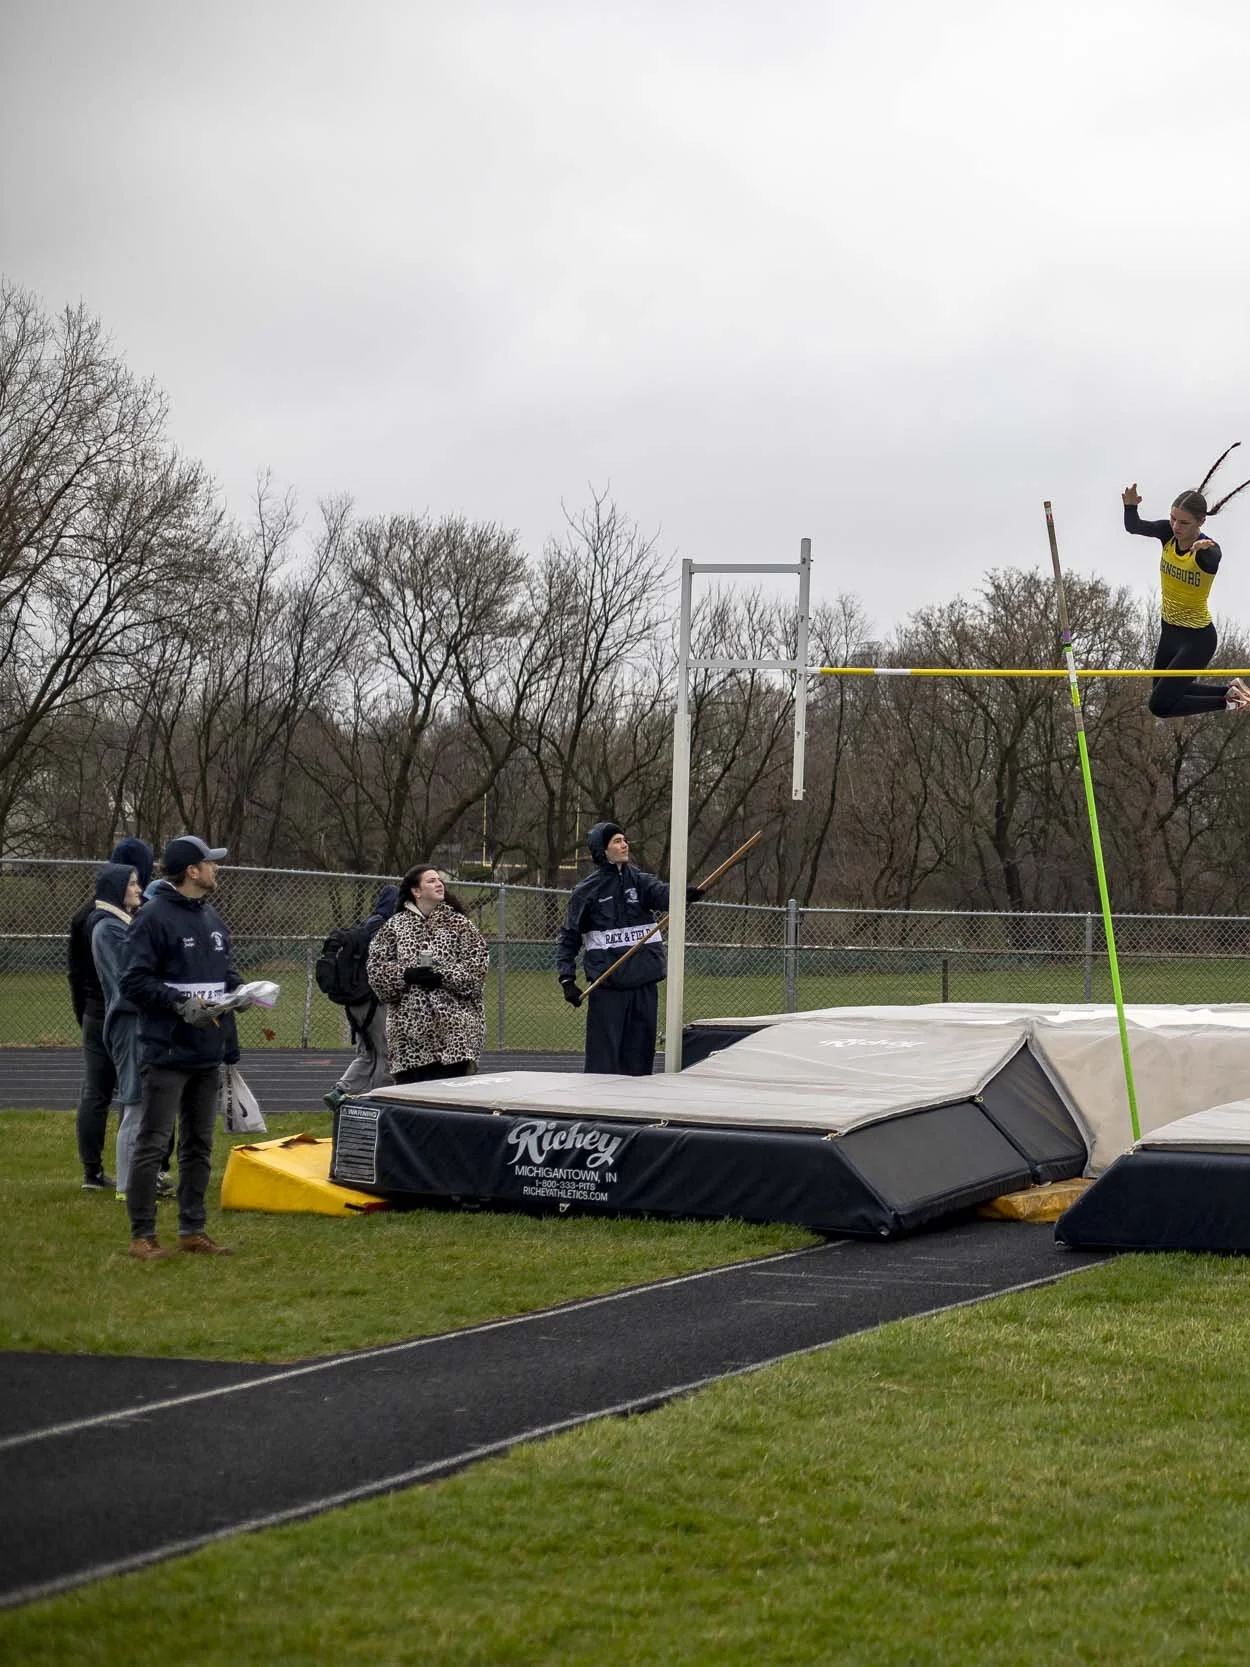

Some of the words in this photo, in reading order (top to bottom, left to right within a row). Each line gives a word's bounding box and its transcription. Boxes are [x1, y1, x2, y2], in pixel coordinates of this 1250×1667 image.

[506, 1121, 622, 1168] Richey
[515, 1165, 600, 1183] MICHIGANTOWN,
[605, 1172, 617, 1183] IN
[523, 1186, 608, 1201] RICHEYATHLETICS.COM
[535, 1180, 596, 1191] 1-800-333-PITS
